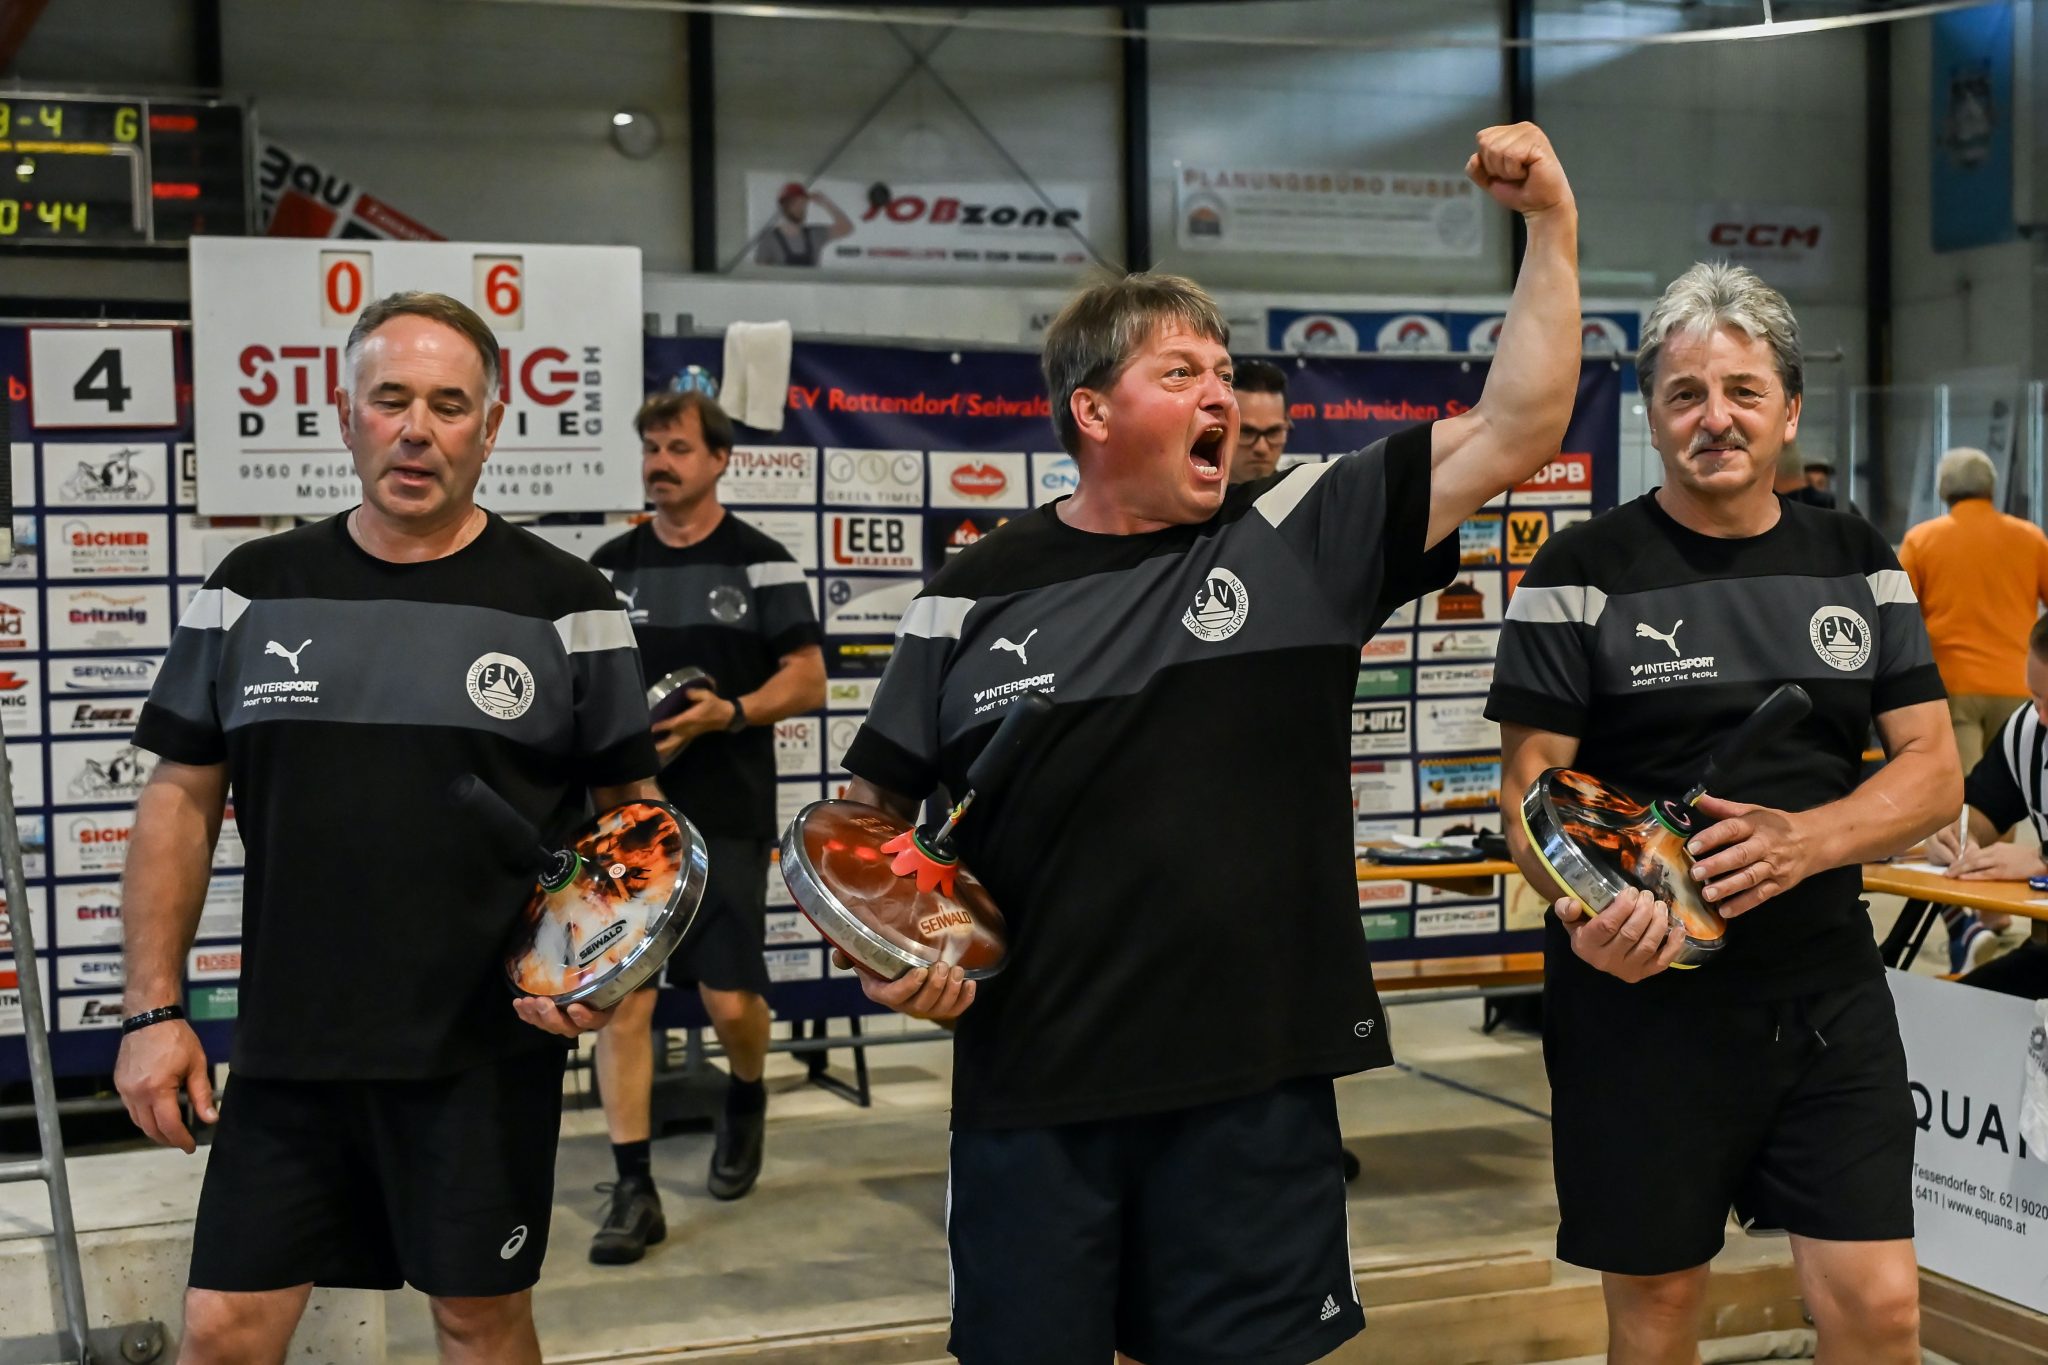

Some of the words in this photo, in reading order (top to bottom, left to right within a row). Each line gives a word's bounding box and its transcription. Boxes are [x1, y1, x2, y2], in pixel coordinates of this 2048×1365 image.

[1709, 223, 1821, 248] CCM
[326, 260, 362, 315] 0
[486, 264, 522, 316] 6
[74, 348, 132, 412] 4
[584, 346, 602, 435] GMBH
[789, 387, 821, 409] EV
[1323, 398, 1438, 421] zahlreichen
[239, 464, 291, 479] 9560
[583, 462, 605, 476] 16
[499, 483, 521, 496] 44
[72, 531, 149, 546] SICHER
[833, 517, 904, 564] LEEB
[73, 664, 148, 677] SEIWALD
[1421, 668, 1495, 682] RITZINGE
[1644, 656, 1714, 675] INTERSPORT
[253, 680, 319, 694] INTERSPORT
[986, 673, 1055, 700] INTERSPORT
[1632, 677, 1656, 686] SPORT
[1658, 676, 1671, 684] TO
[1672, 673, 1689, 681] THE
[1692, 670, 1718, 680] PEOPLE
[262, 696, 272, 704] TO
[290, 695, 319, 704] PEOPLE
[974, 701, 995, 715] SPORT
[920, 905, 972, 935] SEIWALD
[579, 924, 624, 960] SEIWALD
[1913, 1162, 1977, 1197] Tessendorfer
[1980, 1184, 1996, 1205] Str.
[1999, 1192, 2013, 1209] 62
[1915, 1184, 1939, 1206] 6411
[1947, 1198, 2027, 1236] www.equans.at
